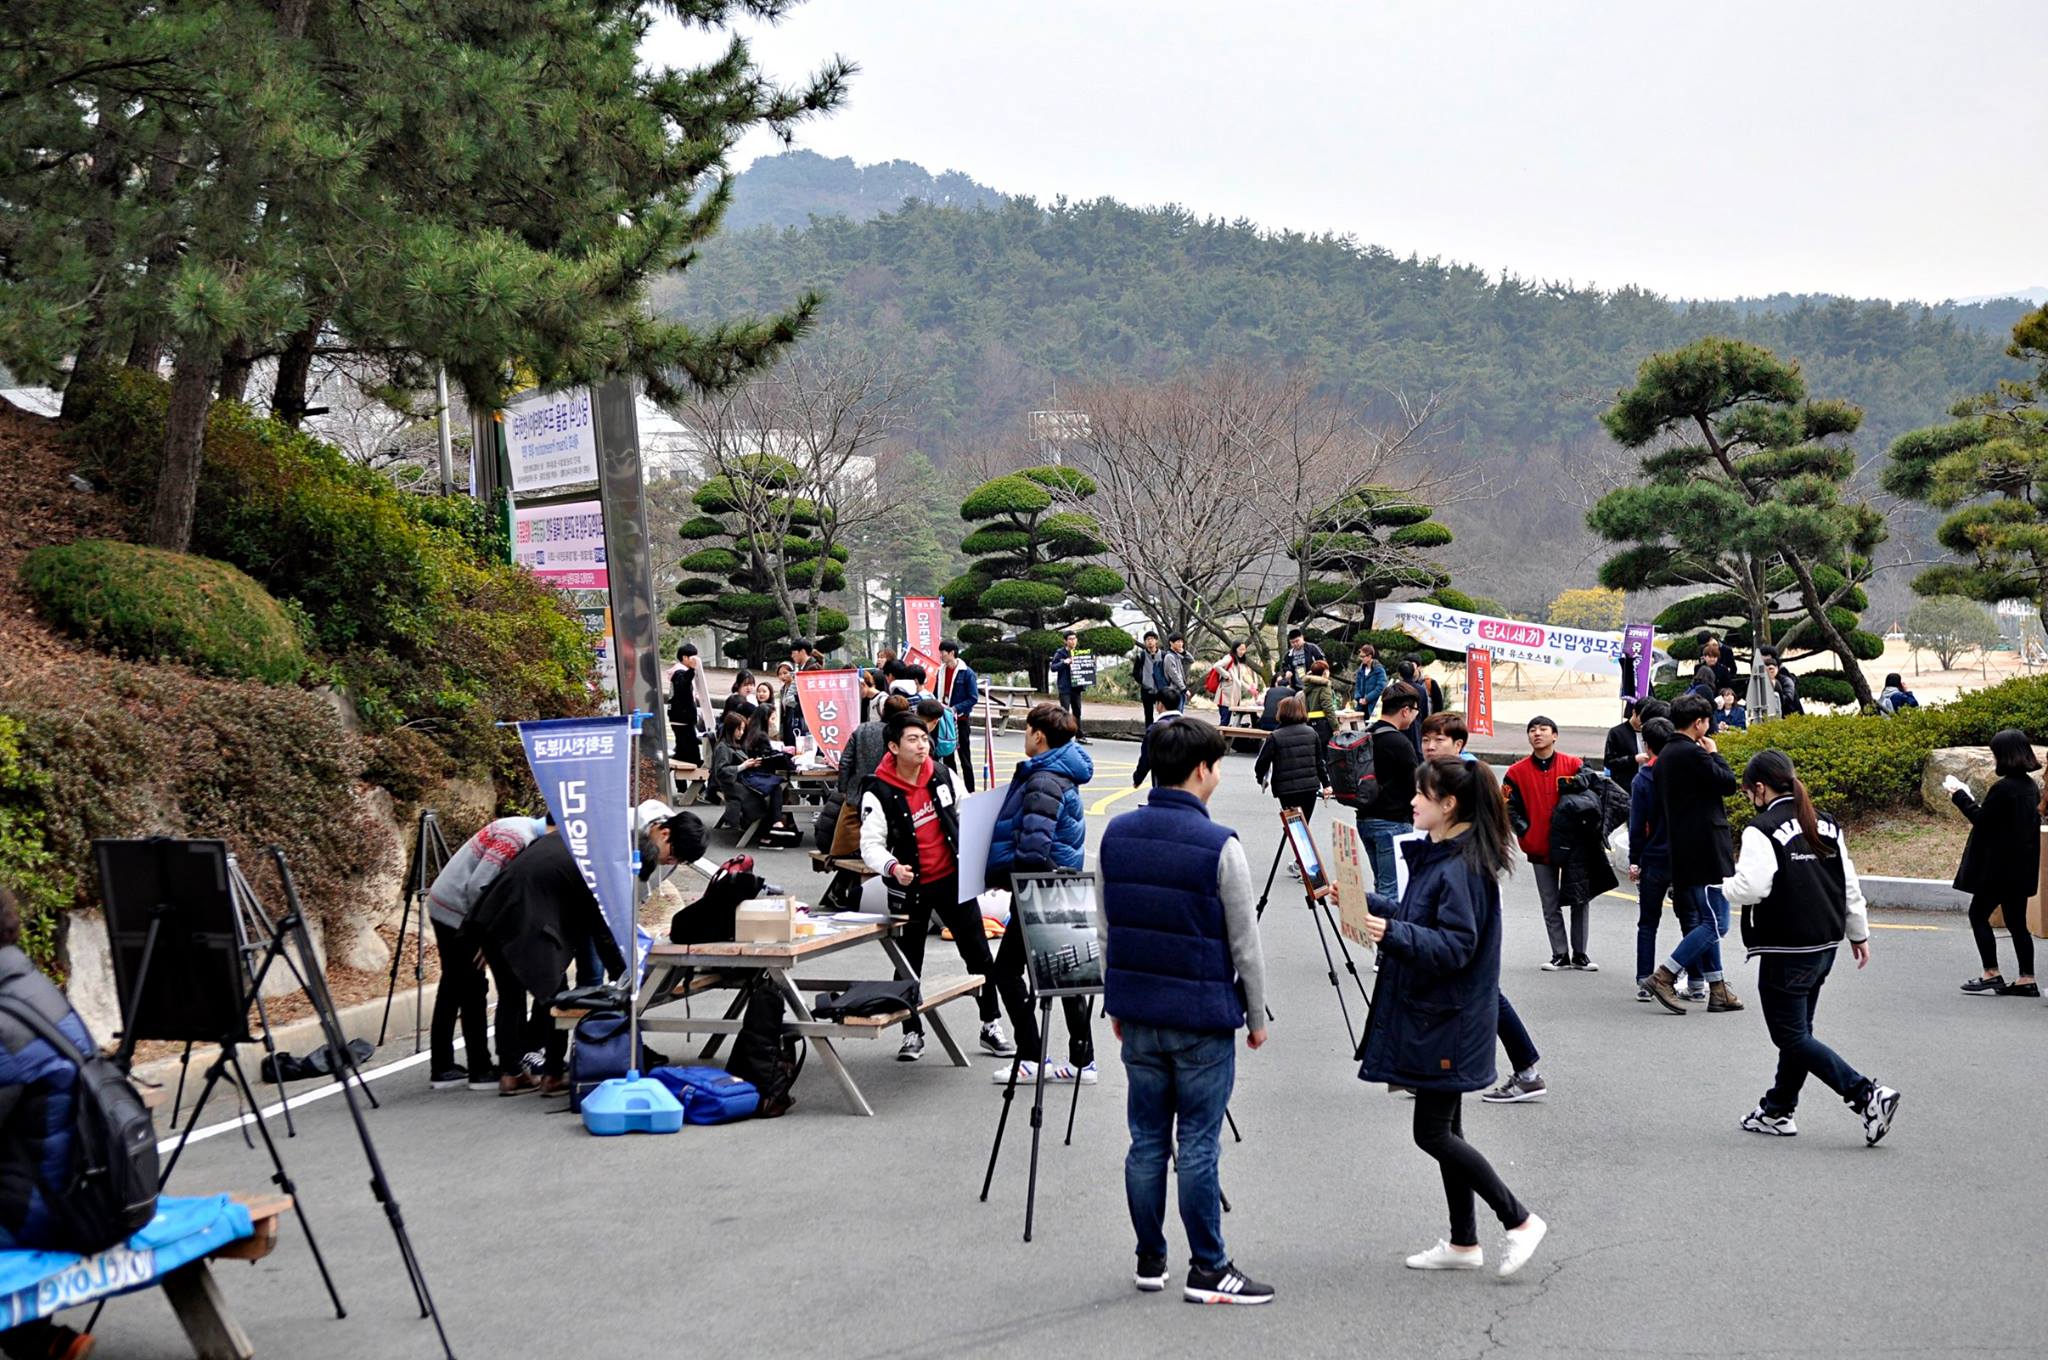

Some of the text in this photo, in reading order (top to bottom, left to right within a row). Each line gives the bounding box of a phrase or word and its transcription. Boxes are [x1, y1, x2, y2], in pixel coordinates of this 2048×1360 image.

[1429, 612, 1475, 635] 유스랑
[1483, 621, 1541, 645] 삼시세끼
[1548, 631, 1624, 658] 신입생모집
